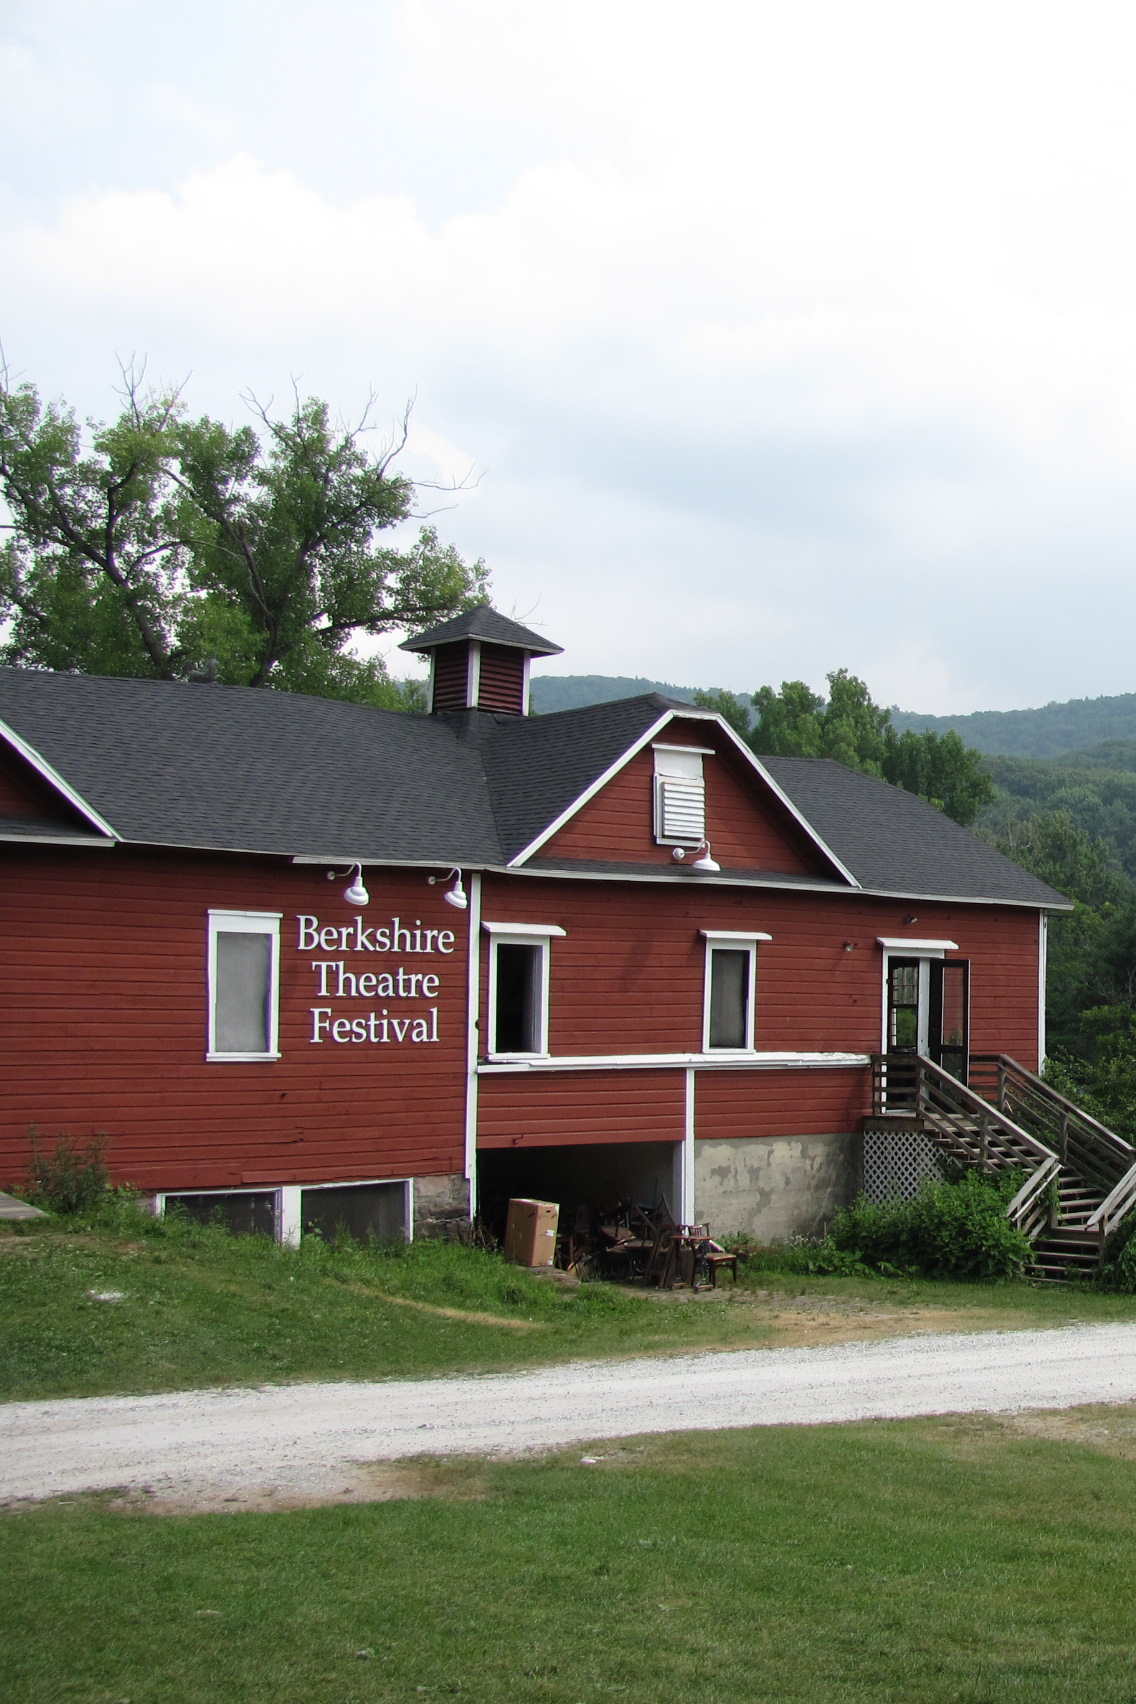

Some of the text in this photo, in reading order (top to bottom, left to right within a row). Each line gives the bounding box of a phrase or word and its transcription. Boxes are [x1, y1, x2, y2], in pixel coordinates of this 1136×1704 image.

[296, 915, 455, 954] Berkshire
[311, 961, 440, 998] Theatre
[309, 1007, 440, 1043] Festival
